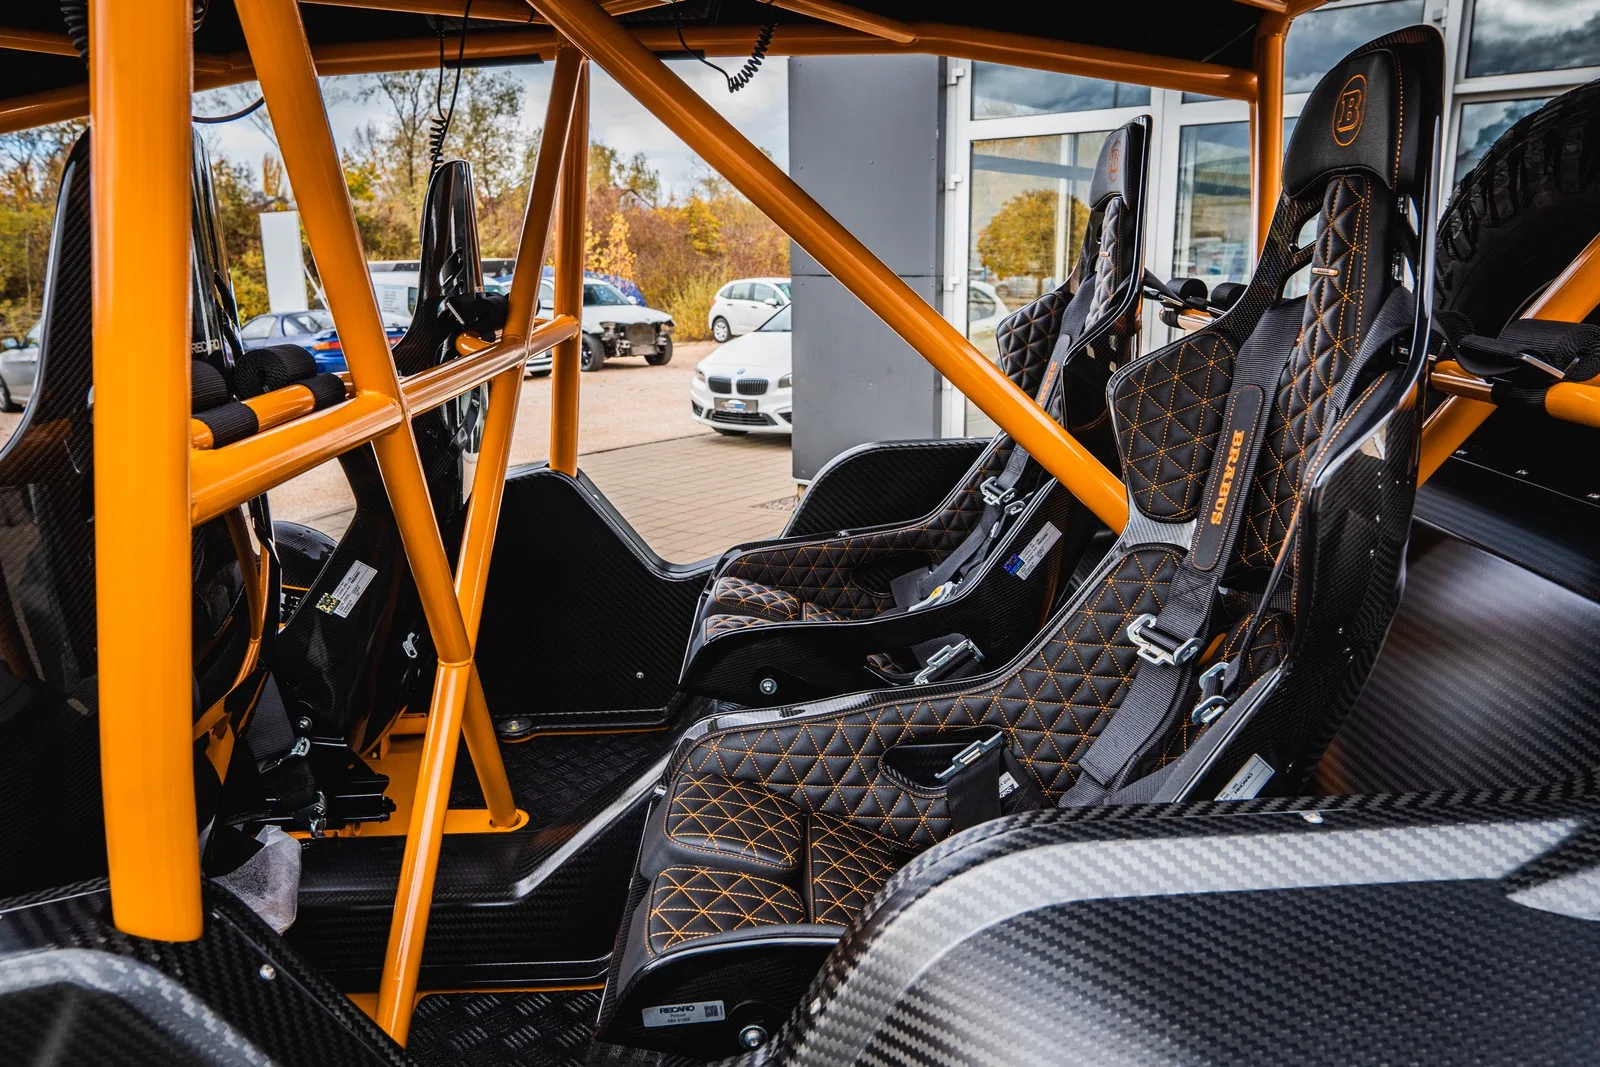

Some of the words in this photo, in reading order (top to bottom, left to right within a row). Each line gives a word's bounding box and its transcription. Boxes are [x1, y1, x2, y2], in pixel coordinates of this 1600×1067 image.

[1337, 89, 1362, 132] B
[191, 339, 220, 354] RECRO
[1210, 429, 1245, 525] BRABUS
[659, 1004, 695, 1014] RECARO
